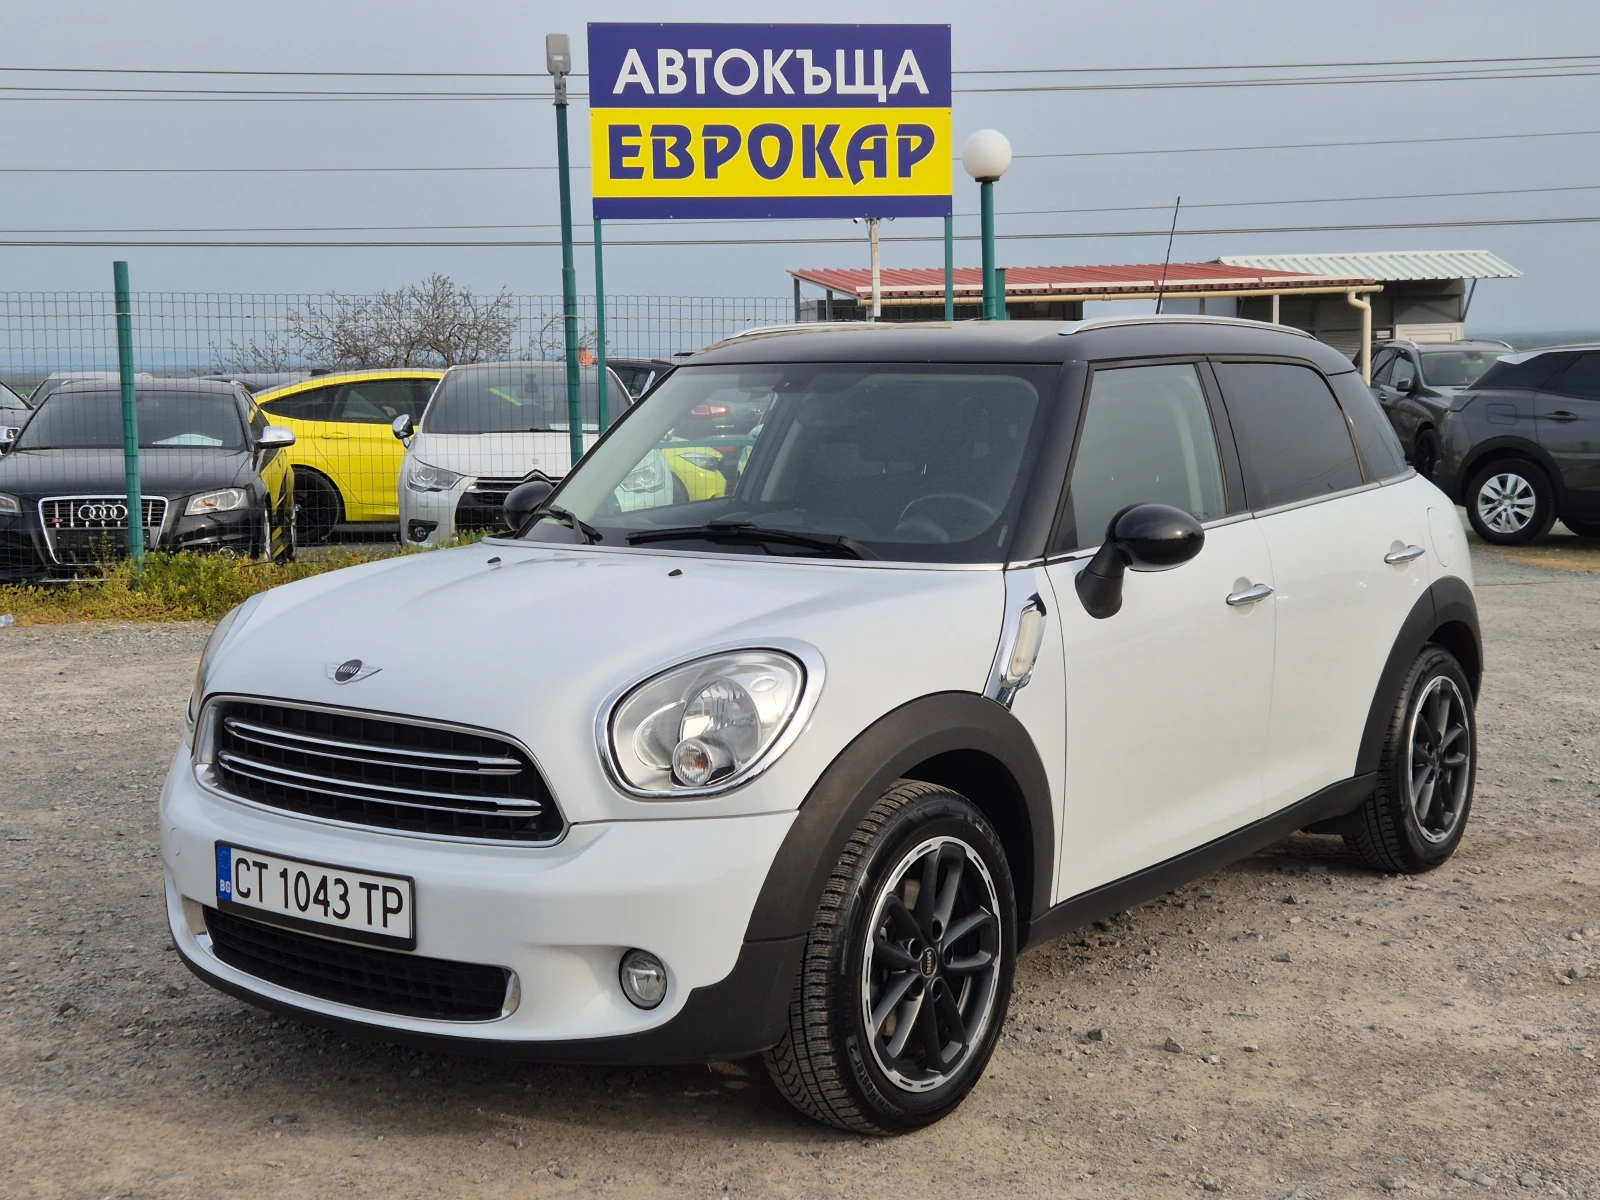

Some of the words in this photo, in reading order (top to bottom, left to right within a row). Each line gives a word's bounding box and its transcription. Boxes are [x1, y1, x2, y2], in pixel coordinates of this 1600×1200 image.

[612, 48, 929, 103] АВТОКЪЩА
[608, 123, 936, 187] ЕВРОКАР
[338, 665, 360, 675] MINI
[219, 879, 232, 893] BG
[235, 857, 269, 904] CT
[279, 867, 351, 920] 1043
[359, 881, 404, 928] TP
